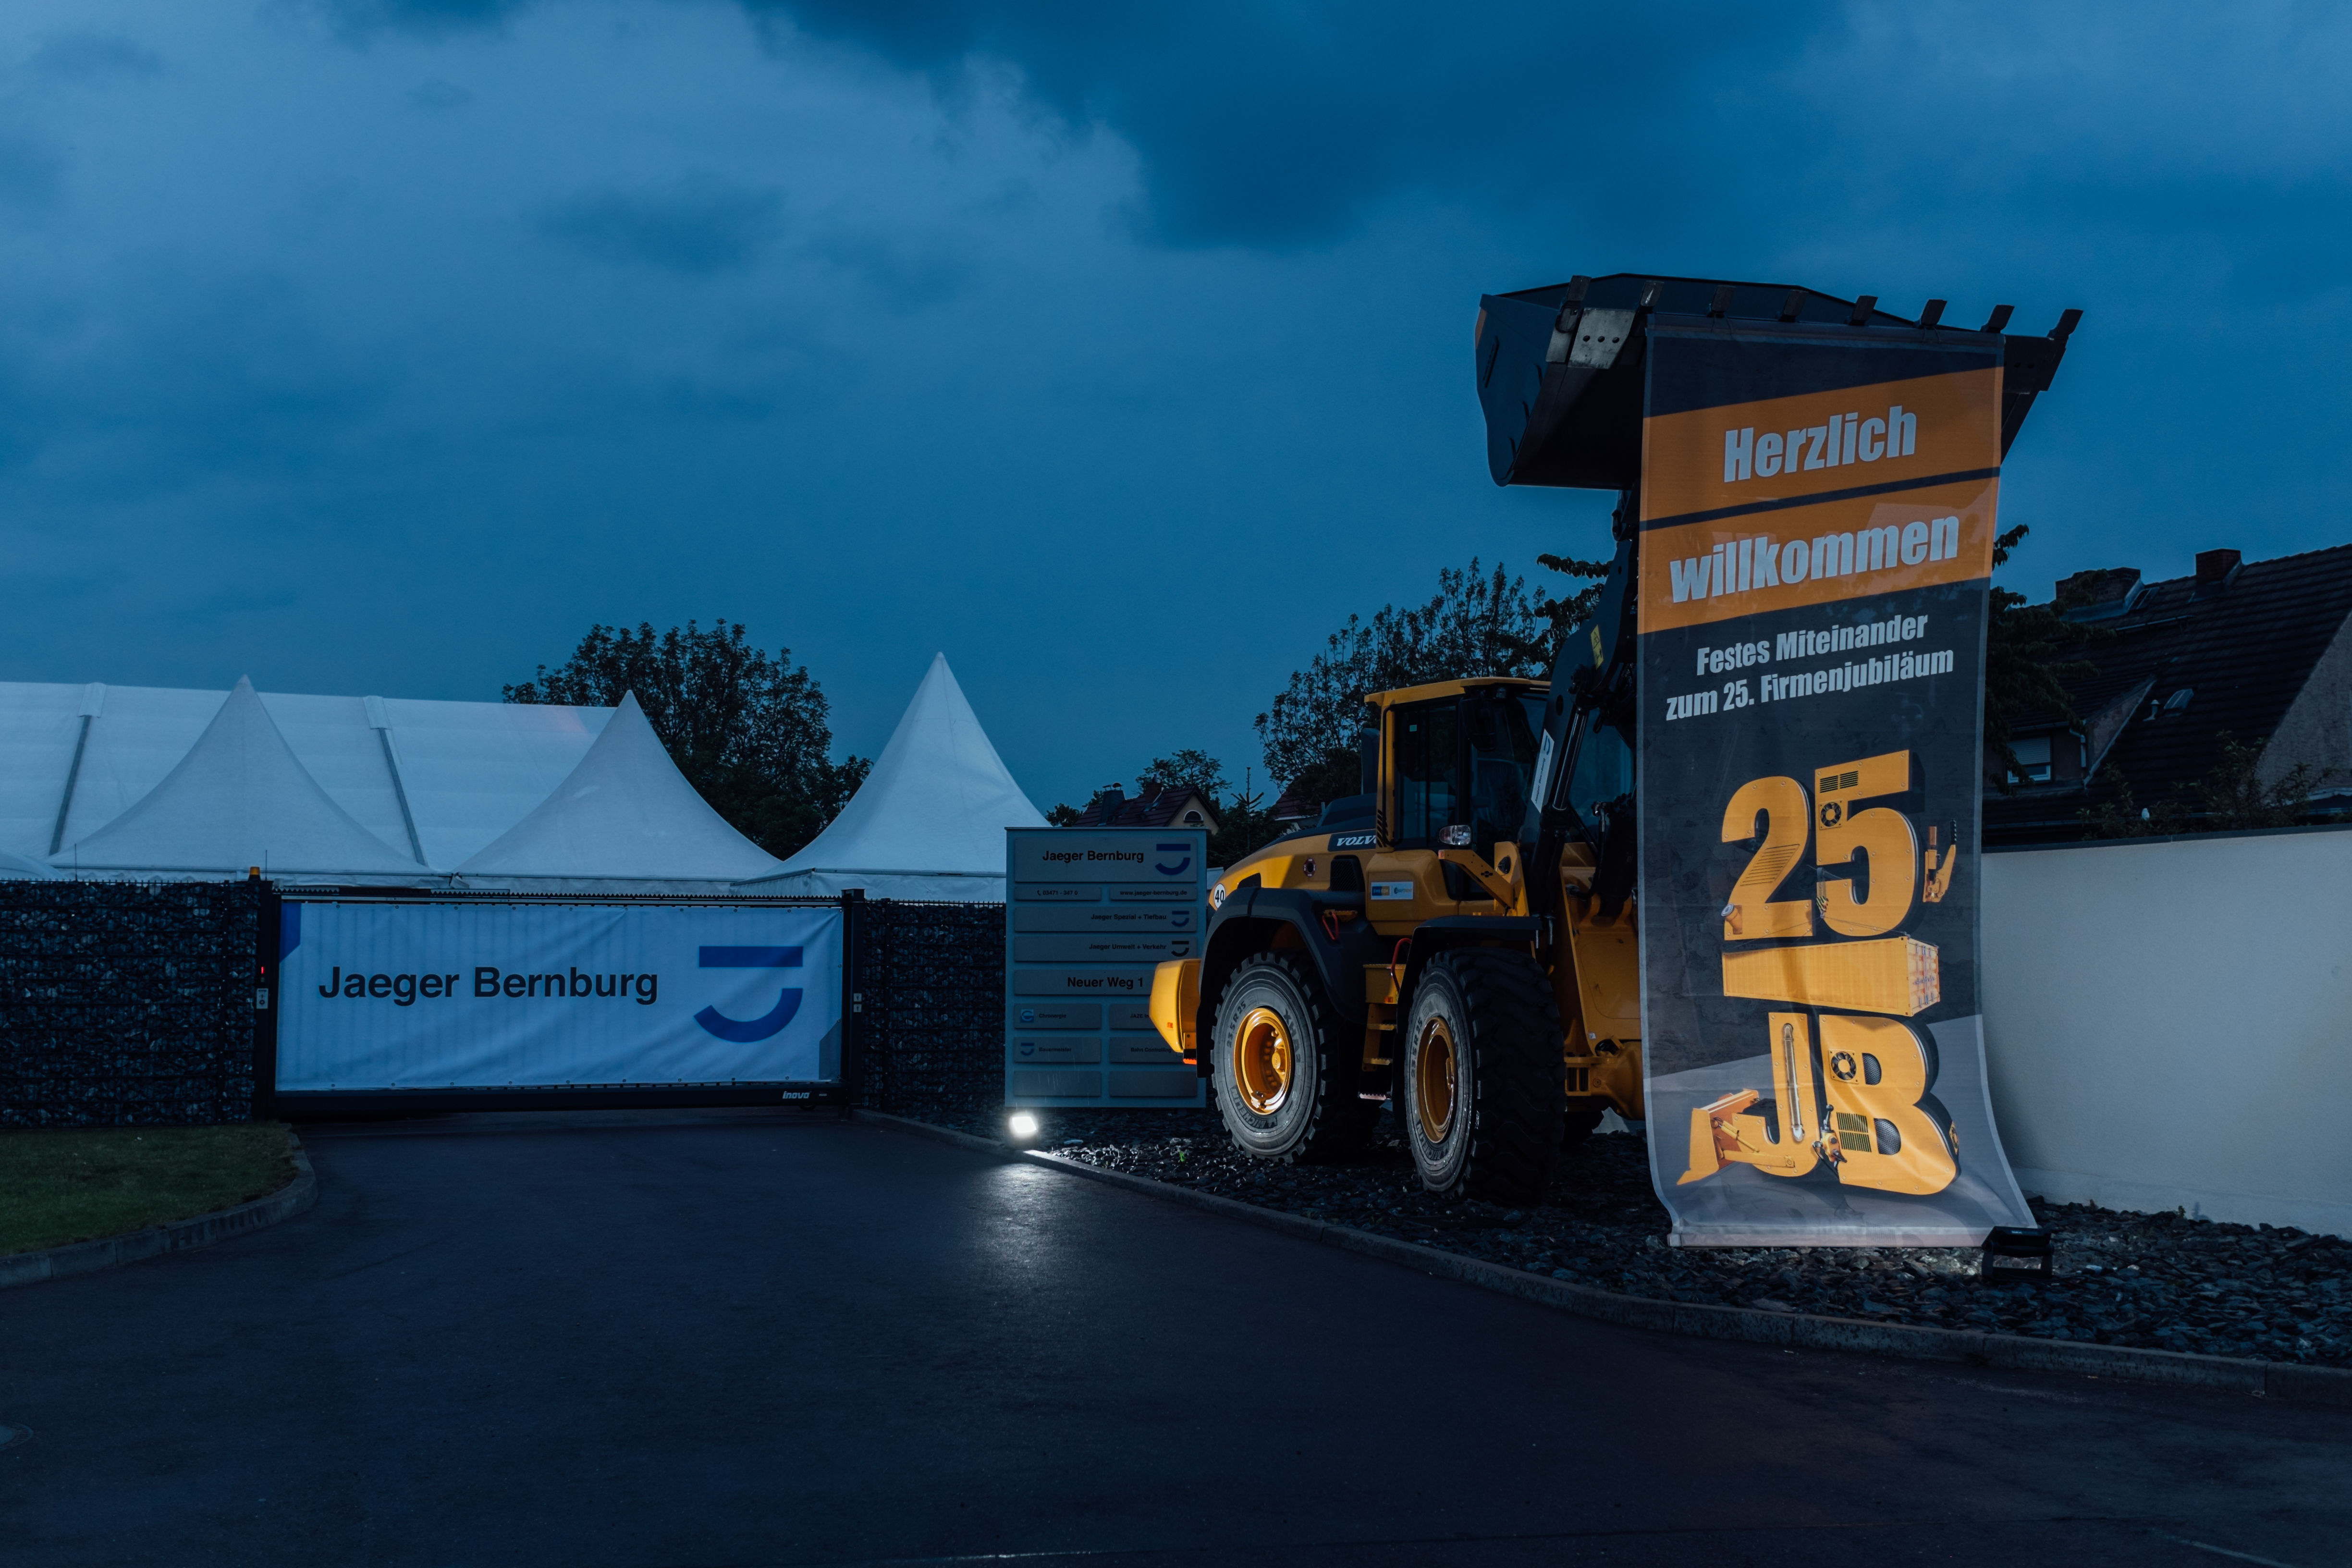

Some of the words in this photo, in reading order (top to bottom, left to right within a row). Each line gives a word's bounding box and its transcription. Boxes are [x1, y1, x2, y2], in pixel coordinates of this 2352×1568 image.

[1724, 405, 1916, 482] Herzlich
[1669, 516, 1959, 603] willkommen
[1696, 639, 1770, 676] Festes
[1776, 614, 1928, 661] Miteinander
[1666, 688, 1717, 721] zum
[1723, 679, 1754, 711] 25.
[1760, 649, 1954, 704] Firmenjubiläum
[1042, 851, 1083, 863] Jaeger
[1088, 851, 1144, 863] Bernburg
[1337, 835, 1376, 846] VOLV
[1721, 749, 1920, 940] 25
[1215, 890, 1225, 903] 40
[318, 966, 460, 1006] Jaeger
[474, 966, 658, 1005] Bernburg
[1067, 977, 1103, 987] Neuer
[1107, 977, 1134, 990] Weg
[1138, 977, 1143, 987] 1
[1232, 1013, 1239, 1023] R
[1237, 1001, 1247, 1015] 25
